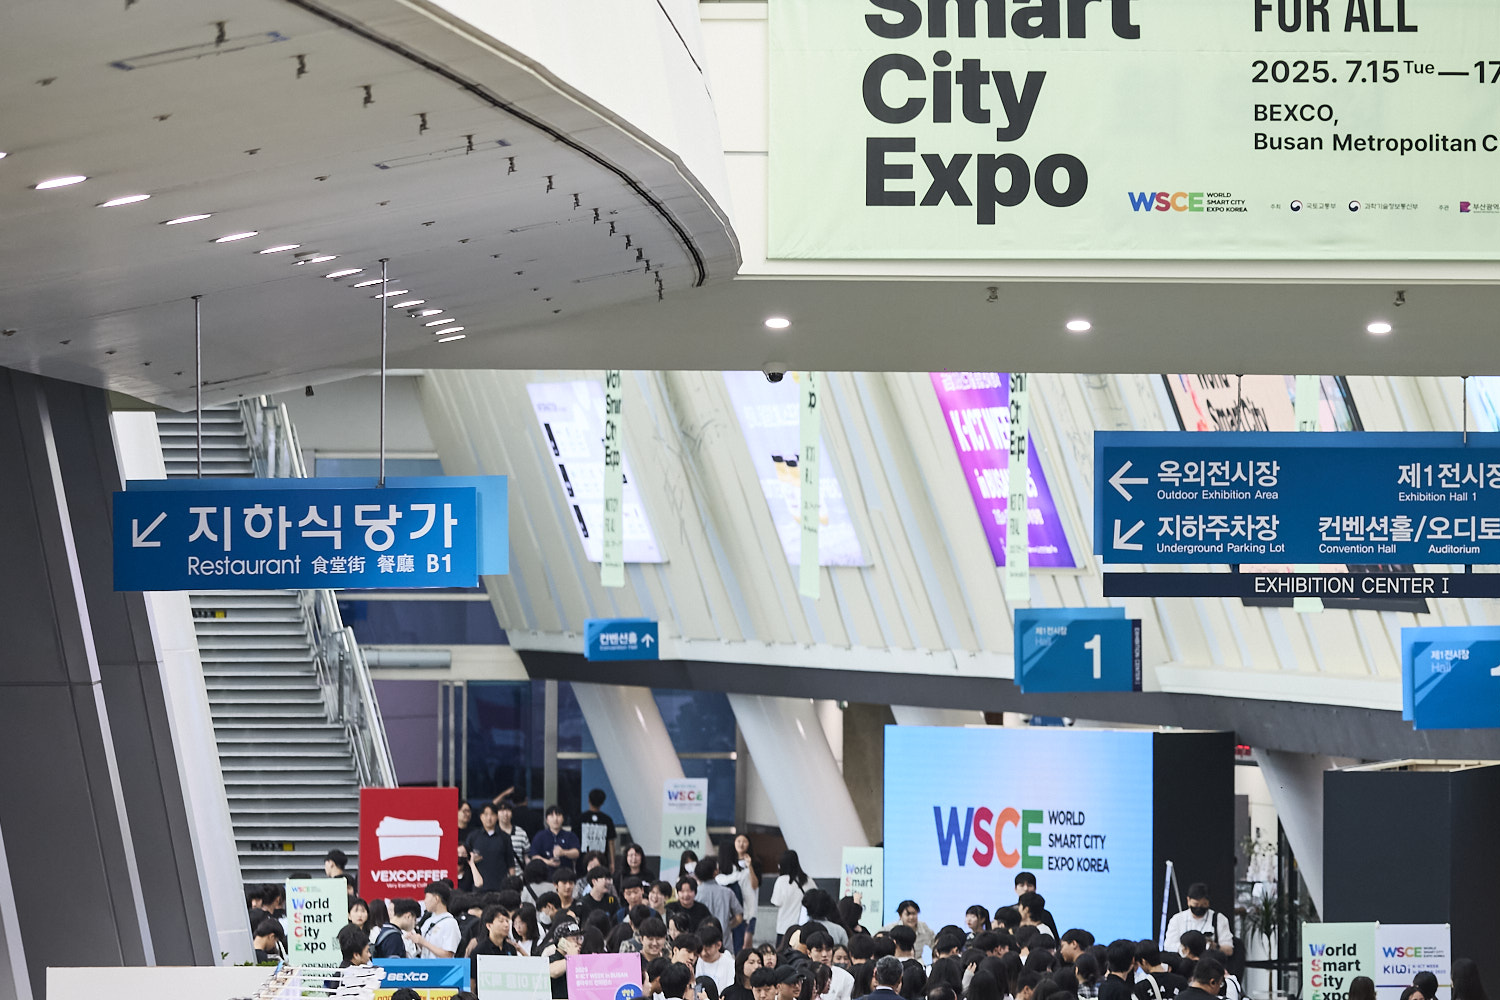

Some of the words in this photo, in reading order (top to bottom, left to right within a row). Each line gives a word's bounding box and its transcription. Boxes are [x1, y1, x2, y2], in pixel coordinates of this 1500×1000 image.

[865, 0, 1140, 39] Smart
[1254, 0, 1330, 32] FOR
[1344, 0, 1418, 32] ALL
[1251, 59, 1338, 84] 2025.
[862, 50, 1047, 141] City
[1253, 104, 1339, 126] BEXCO,
[1253, 132, 1323, 151] Busan
[1332, 132, 1477, 156] Metropolitan
[864, 137, 1089, 225] Expo
[1127, 191, 1204, 212] WSCE
[1156, 459, 1280, 488] 옥외전시장
[1156, 489, 1199, 500] Outdoor
[1202, 489, 1251, 500] Exhibition
[1253, 489, 1279, 500] Area
[1398, 491, 1447, 502] Exhibition
[1449, 491, 1470, 502] Hall
[1472, 492, 1477, 502] 1
[188, 502, 458, 552] 지하식당가
[1156, 513, 1279, 541] 지하주차장
[1156, 542, 1223, 554] Underground
[1226, 542, 1267, 554] Parking
[1270, 543, 1285, 554] Lot
[1318, 543, 1374, 554] Convention
[1377, 543, 1396, 554] Hall
[1428, 543, 1480, 554] Auditorium
[188, 554, 302, 576] Restaurant
[312, 555, 366, 574] 食堂街
[377, 554, 415, 574] 餐廳
[426, 554, 452, 573] B1
[1254, 577, 1354, 594] EXHIBITION
[1361, 577, 1437, 594] CENTER
[1084, 633, 1102, 679] 1
[1430, 649, 1470, 660] 제1전시장
[1431, 661, 1452, 673] Hall
[1048, 810, 1086, 826] WORLD
[674, 825, 696, 836] VIP
[933, 806, 1044, 870] WSCE
[669, 840, 700, 849] ROOM
[1048, 834, 1082, 849] SMART
[1084, 835, 1106, 850] CITY
[846, 864, 873, 875] World
[1048, 857, 1074, 872] EXPO
[1077, 858, 1110, 873] KOREA
[846, 877, 874, 887] Smart
[292, 898, 329, 910] World
[294, 912, 332, 923] Smart
[294, 925, 320, 938] City
[295, 940, 327, 953] Expo
[1309, 943, 1357, 957] World
[1382, 946, 1422, 957] WSCE
[1311, 959, 1361, 972] Smart
[1311, 974, 1344, 990] City
